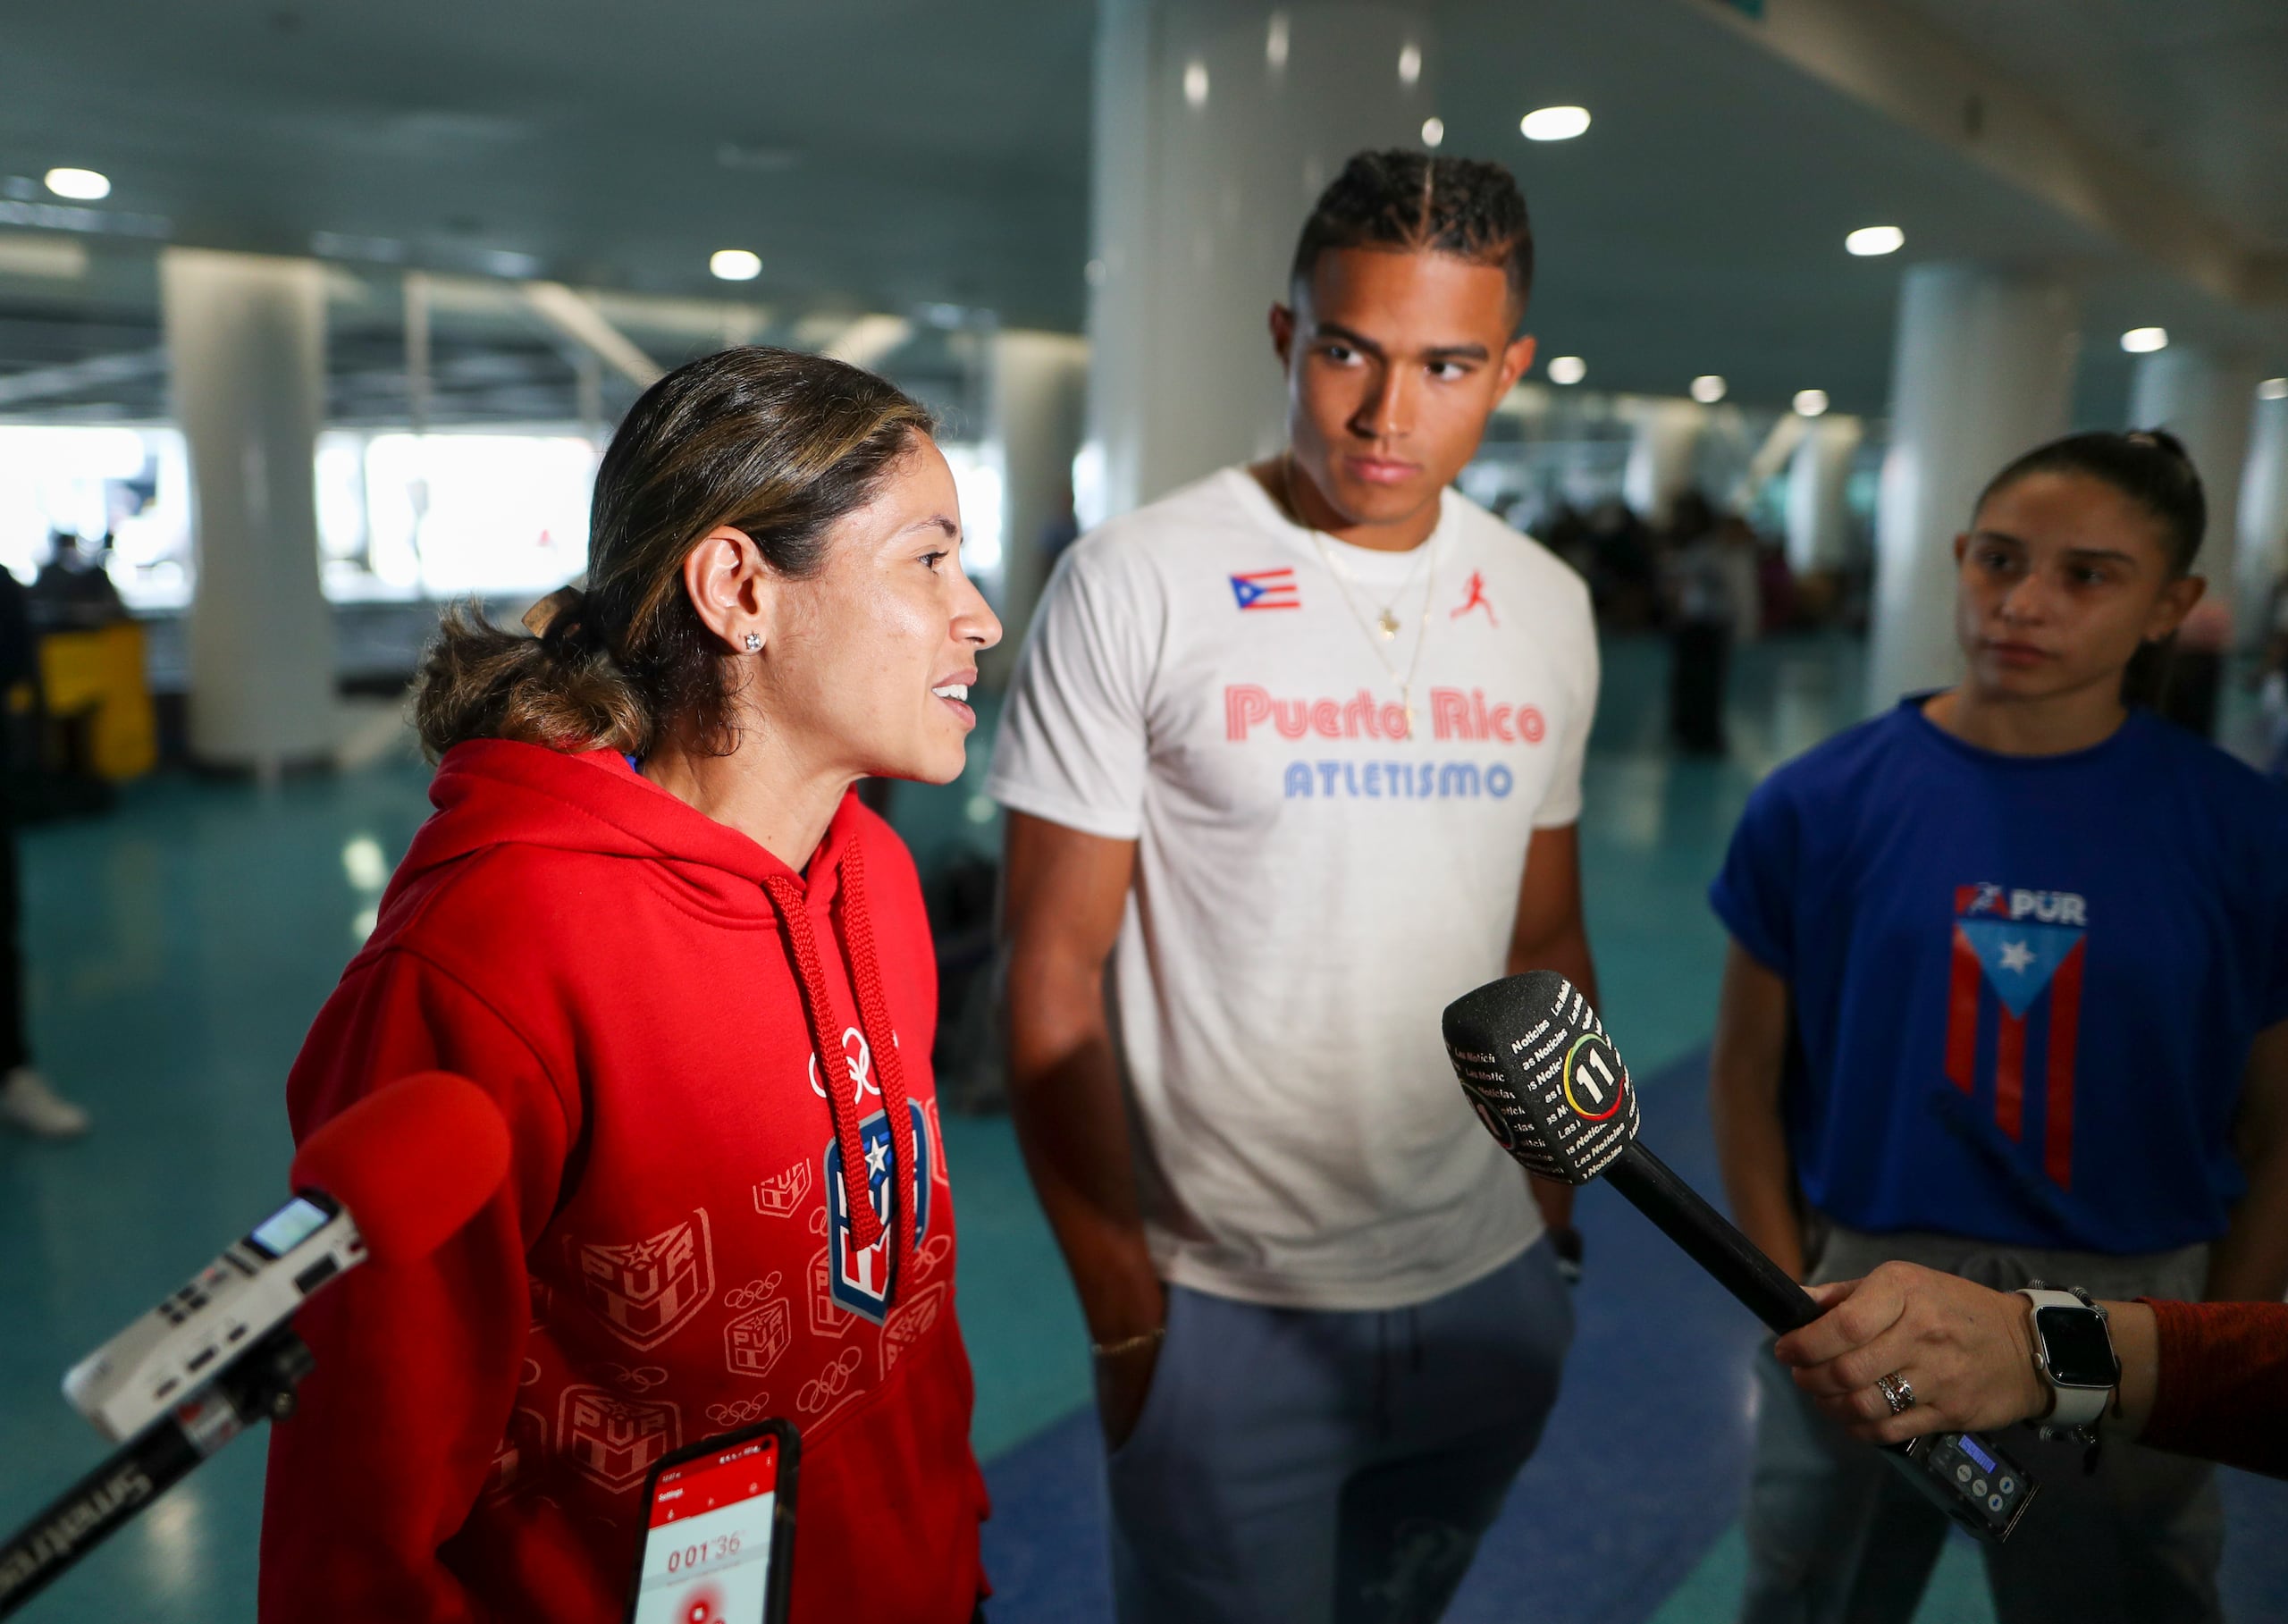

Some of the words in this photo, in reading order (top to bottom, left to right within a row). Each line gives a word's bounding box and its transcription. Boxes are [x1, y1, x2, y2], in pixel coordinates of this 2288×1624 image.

[1224, 685, 1409, 743] Puerto
[1430, 688, 1545, 744] Rico
[1284, 761, 1513, 798] ATLETISMO
[1511, 1019, 1551, 1055] Noticias
[1534, 1028, 1568, 1062] Noticias
[1576, 1047, 1615, 1105] 11
[1558, 1123, 1577, 1140] Las
[1574, 1153, 1591, 1169] Las
[1590, 1122, 1626, 1157] Noticias
[1587, 1144, 1623, 1176] Noticias
